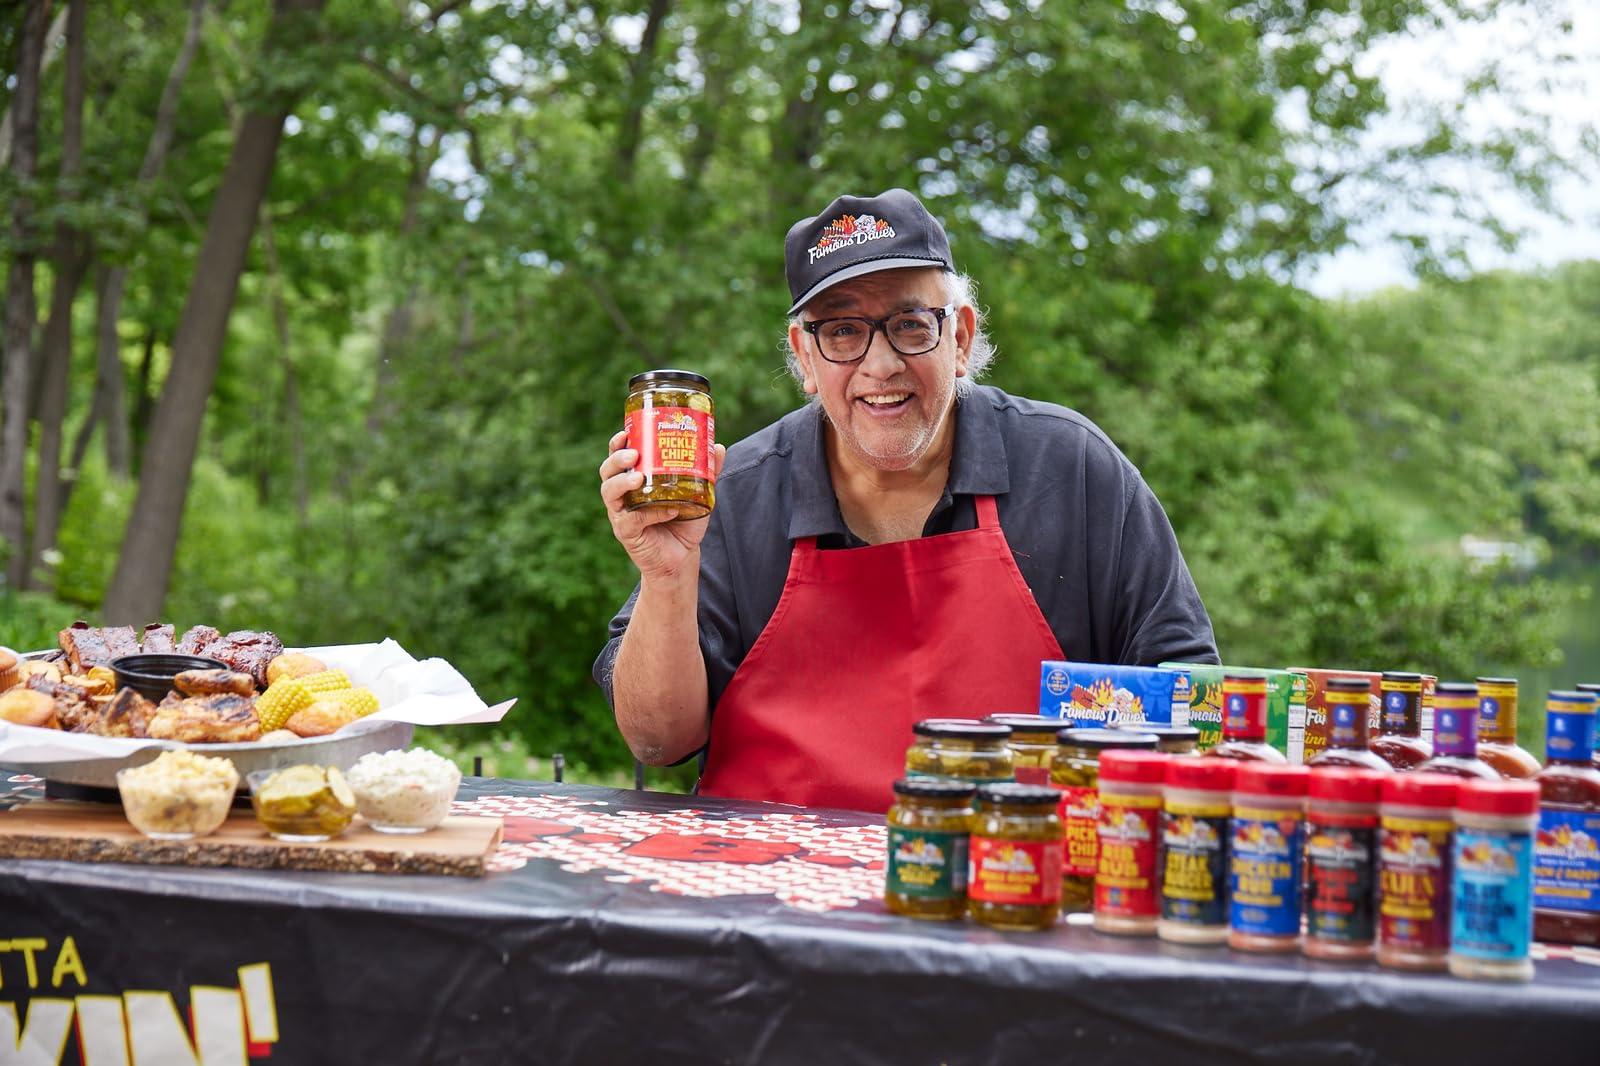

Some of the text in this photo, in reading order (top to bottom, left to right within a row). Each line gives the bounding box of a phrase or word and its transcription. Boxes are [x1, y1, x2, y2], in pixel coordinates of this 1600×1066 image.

[807, 236, 855, 266] Famous
[658, 437, 698, 450] PICKLE
[661, 449, 695, 461] CHIPS
[1060, 702, 1106, 721] Famous
[1189, 710, 1223, 723] mous
[1066, 827, 1097, 842] PICK
